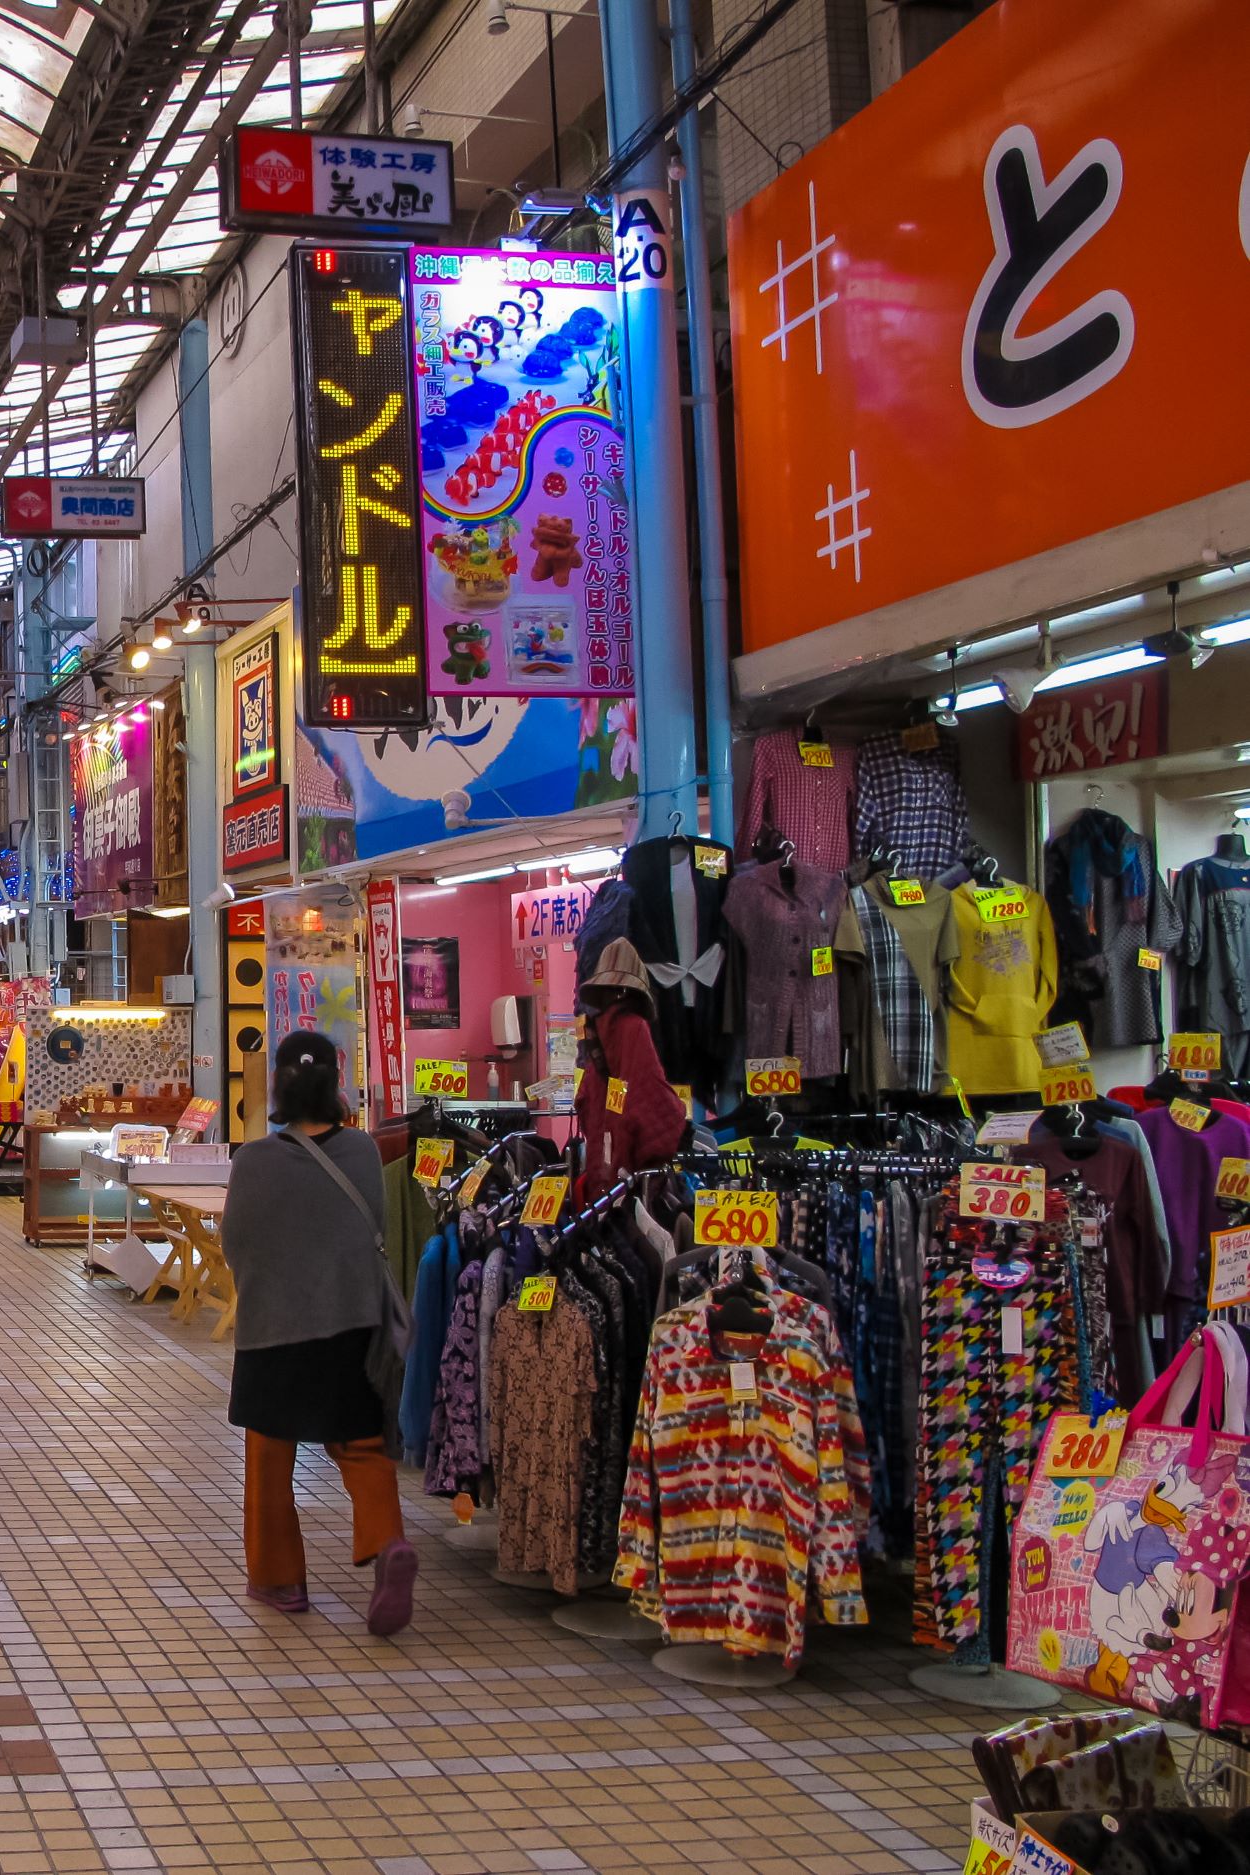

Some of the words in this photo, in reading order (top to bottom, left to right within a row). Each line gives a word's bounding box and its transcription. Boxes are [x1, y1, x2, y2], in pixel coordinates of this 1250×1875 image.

[319, 146, 437, 174] 体験工房
[615, 198, 666, 238] A
[414, 253, 617, 286] 沖縄数の品揃え
[616, 242, 668, 284] 20
[420, 290, 447, 417] ガラス細工販売
[187, 583, 210, 601] A
[749, 1068, 801, 1095] 680
[1043, 1078, 1093, 1104] 1280
[968, 1187, 1032, 1218] 380
[701, 1207, 769, 1246] 680
[1052, 1432, 1111, 1470] 380
